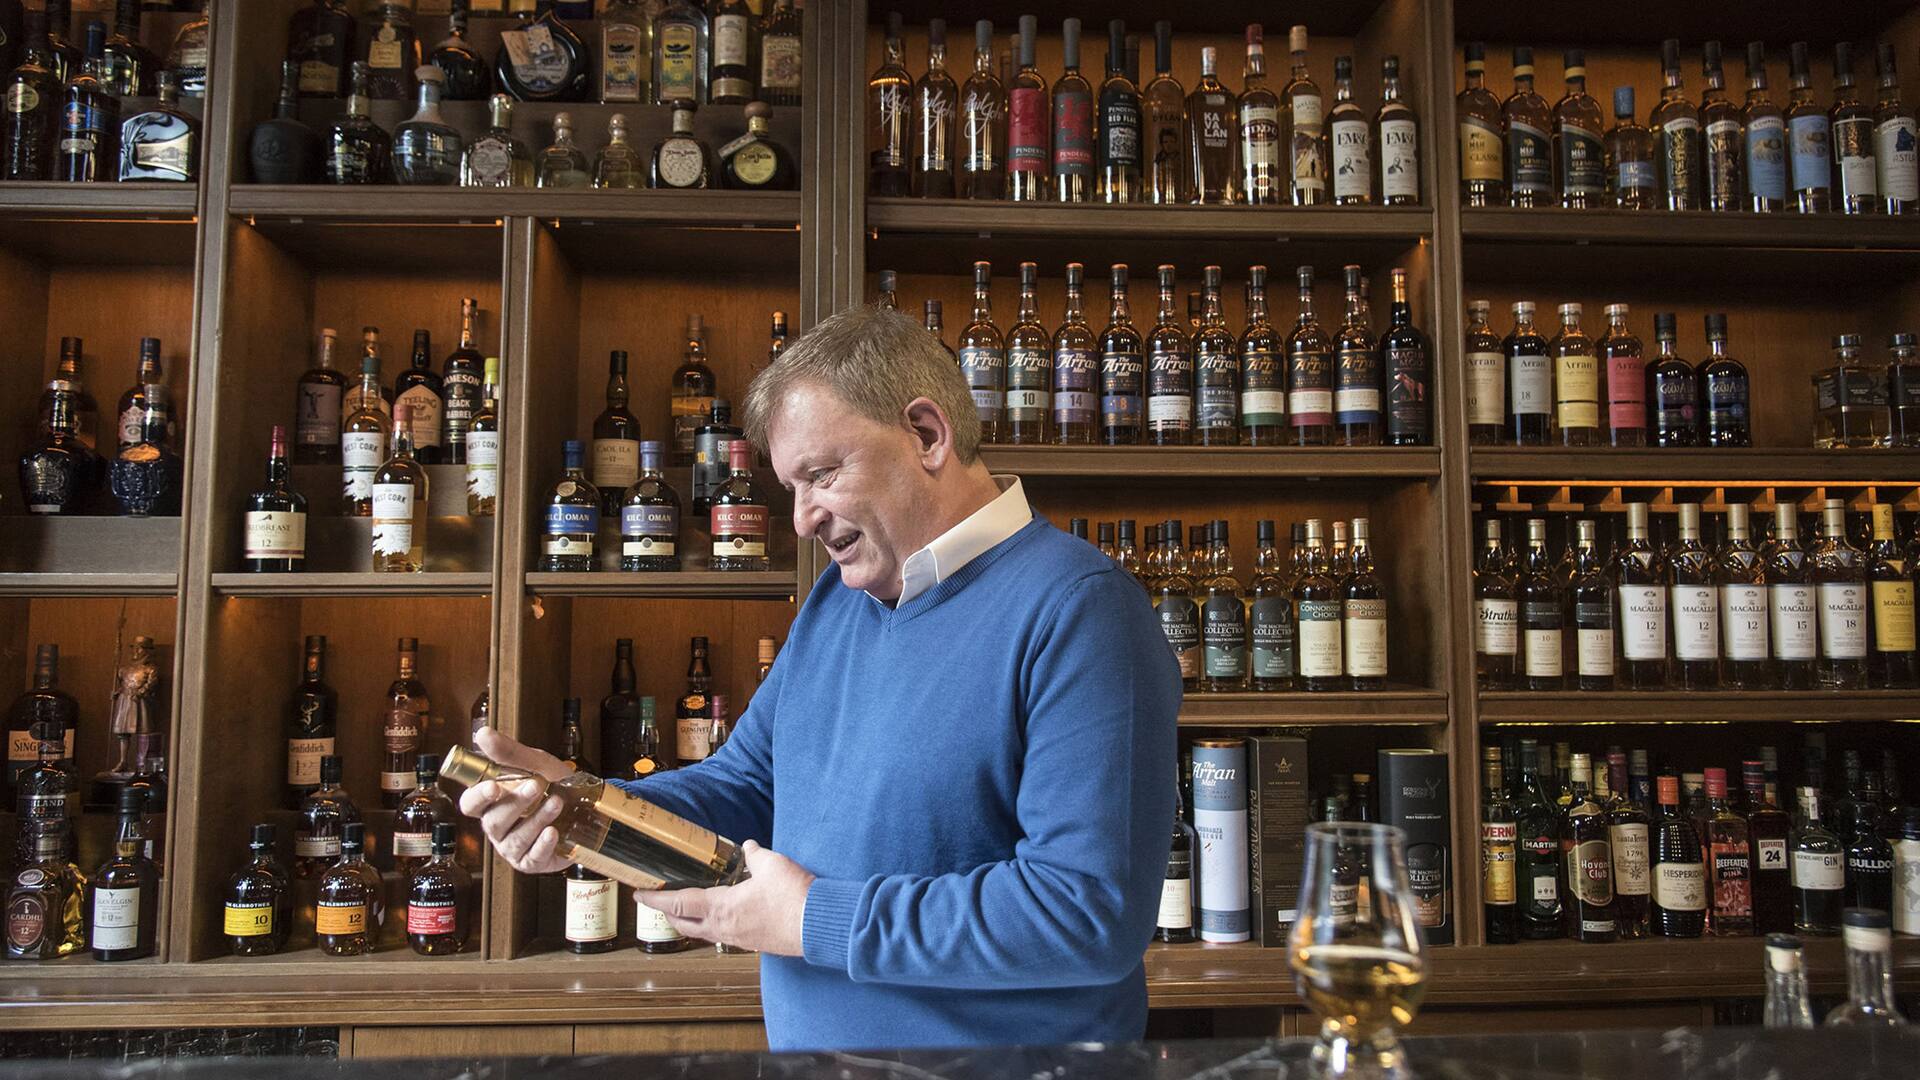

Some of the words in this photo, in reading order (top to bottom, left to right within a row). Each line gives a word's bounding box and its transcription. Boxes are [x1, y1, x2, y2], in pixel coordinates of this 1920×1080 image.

[1204, 112, 1220, 122] KA
[1204, 121, 1220, 130] VA
[1204, 129, 1227, 138] LAN
[961, 351, 1003, 368] Arran
[1008, 351, 1051, 368] Arran
[1056, 353, 1097, 369] Arran
[1102, 356, 1142, 373] Arran
[1150, 355, 1192, 371] Arran
[1197, 355, 1237, 370] Arran
[1520, 359, 1546, 368] Arran
[1565, 361, 1592, 369] Arran
[1022, 392, 1035, 405] 10
[1070, 393, 1083, 407] 14
[1521, 392, 1531, 400] 18
[359, 440, 379, 452] CORK
[387, 494, 407, 504] CORK
[717, 512, 763, 522] KILCOMAN
[261, 539, 271, 548] 12
[1646, 621, 1657, 630] 12
[1699, 621, 1709, 630] 12
[1747, 621, 1758, 630] 12
[1797, 621, 1807, 630] 15
[1845, 619, 1857, 628] 18
[1203, 761, 1216, 769] The
[1192, 761, 1236, 781] Arran
[1201, 778, 1217, 787] Malt
[1525, 840, 1557, 849] MARTINI
[1760, 841, 1784, 849] BEEFEATER
[1765, 850, 1781, 862] 24
[1823, 855, 1838, 866] GIN
[1716, 858, 1749, 868] BEEFEATER
[1589, 869, 1607, 879] Club
[1723, 870, 1743, 878] PINK
[254, 914, 268, 925] 10
[349, 913, 361, 924] 12
[584, 913, 595, 921] 10
[20, 927, 30, 935] 12
